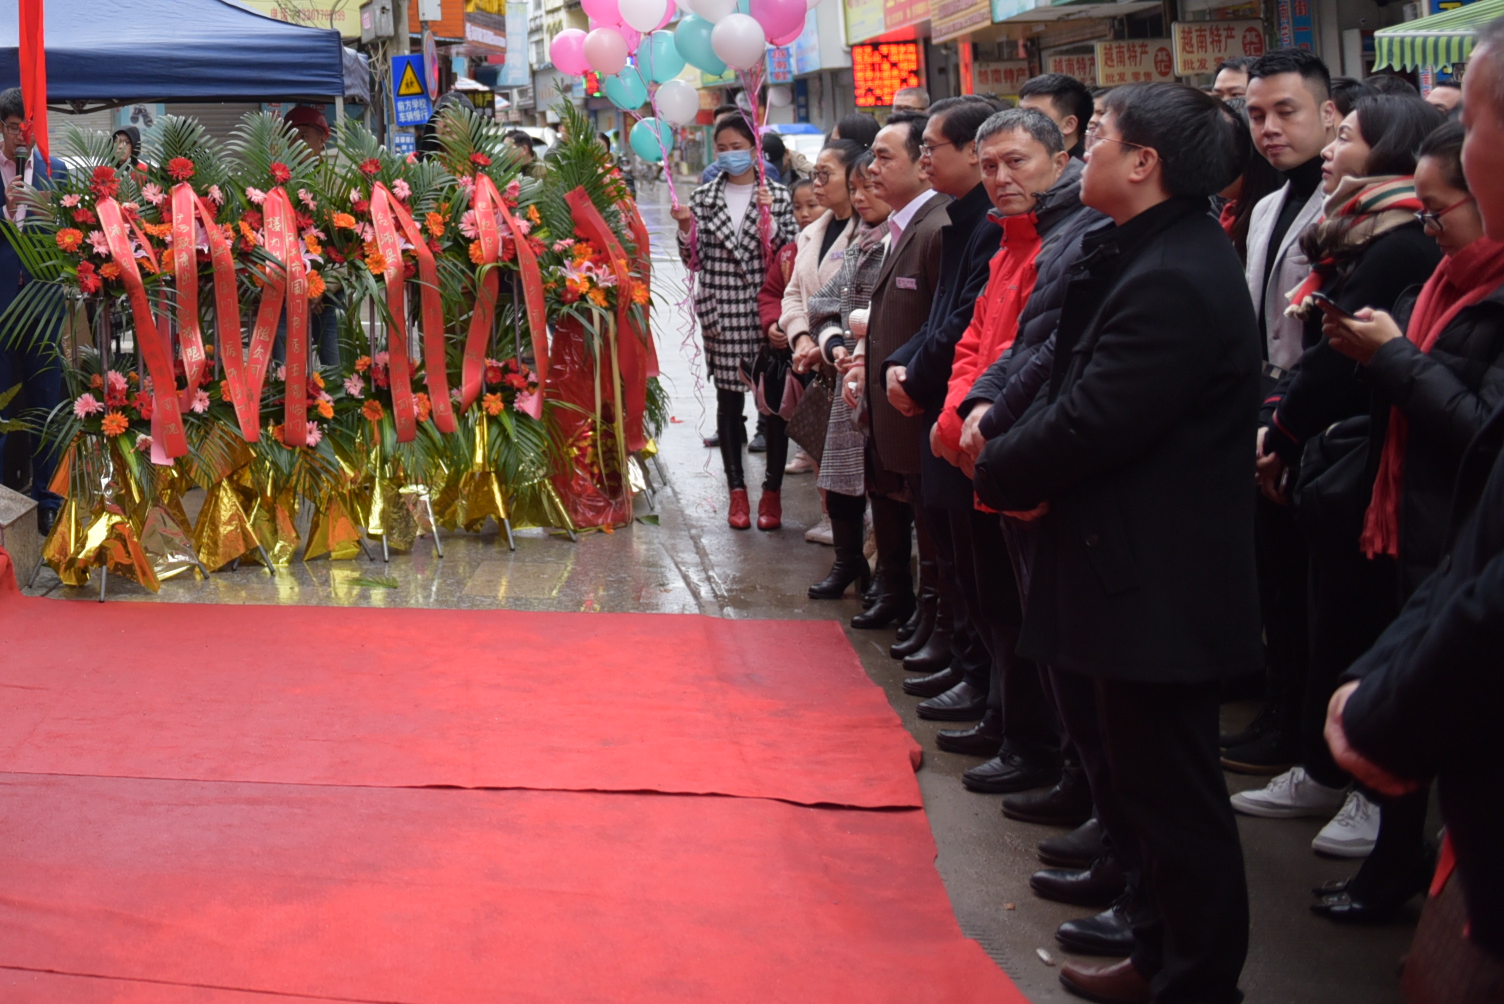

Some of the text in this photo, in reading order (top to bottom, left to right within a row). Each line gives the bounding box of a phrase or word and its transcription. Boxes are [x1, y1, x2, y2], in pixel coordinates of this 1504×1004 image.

[1181, 23, 1236, 54] 越南特产
[1103, 41, 1149, 68] 越南特产
[1182, 57, 1209, 72] 批发
[397, 98, 428, 113] 前方学校
